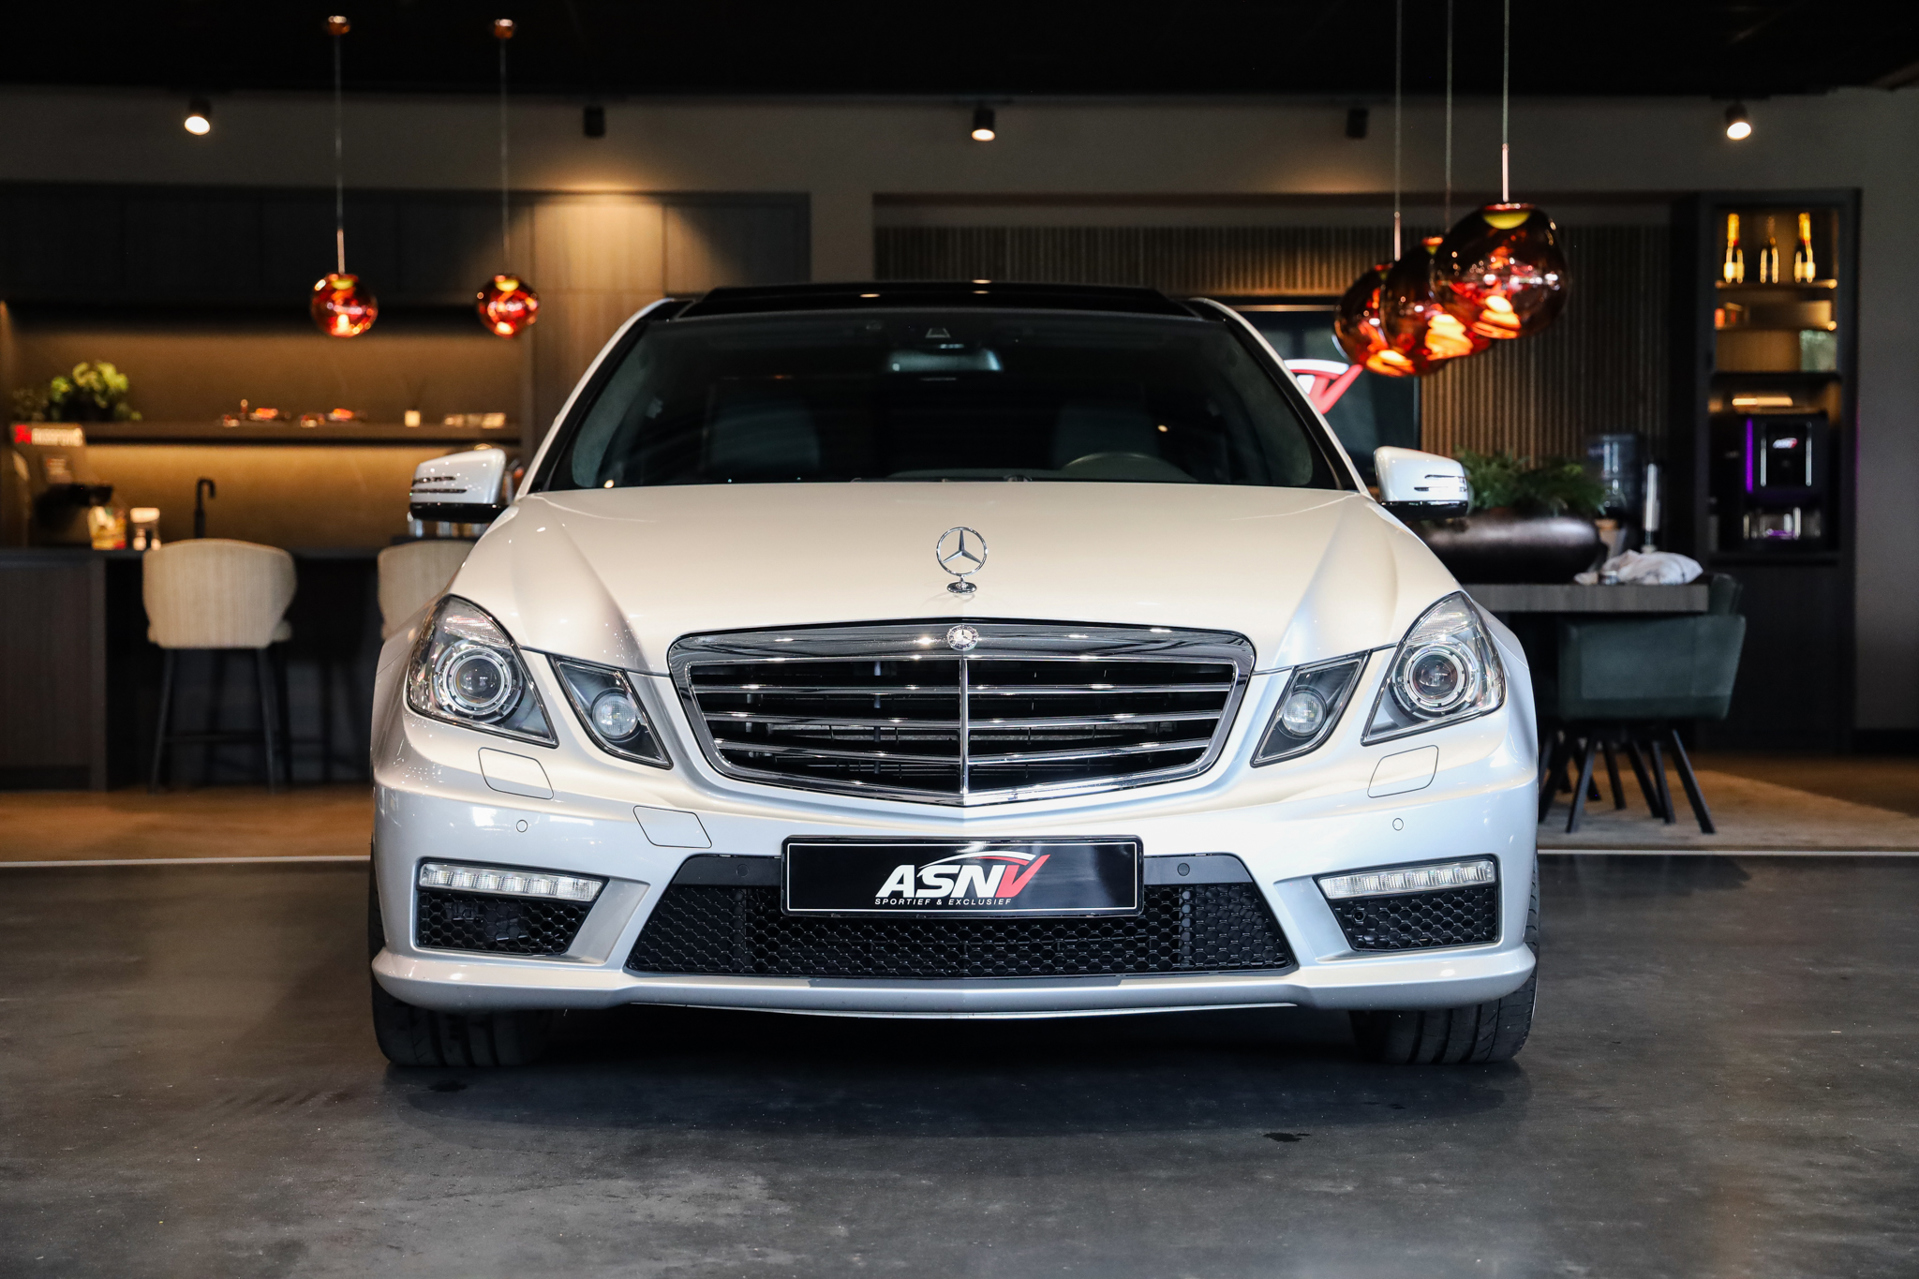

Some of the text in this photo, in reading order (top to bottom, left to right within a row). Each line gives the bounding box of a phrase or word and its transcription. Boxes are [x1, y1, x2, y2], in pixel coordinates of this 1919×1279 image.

[875, 854, 1051, 898] ASNV
[874, 898, 1012, 906] SPORTIEF & EXCLUSIEF
